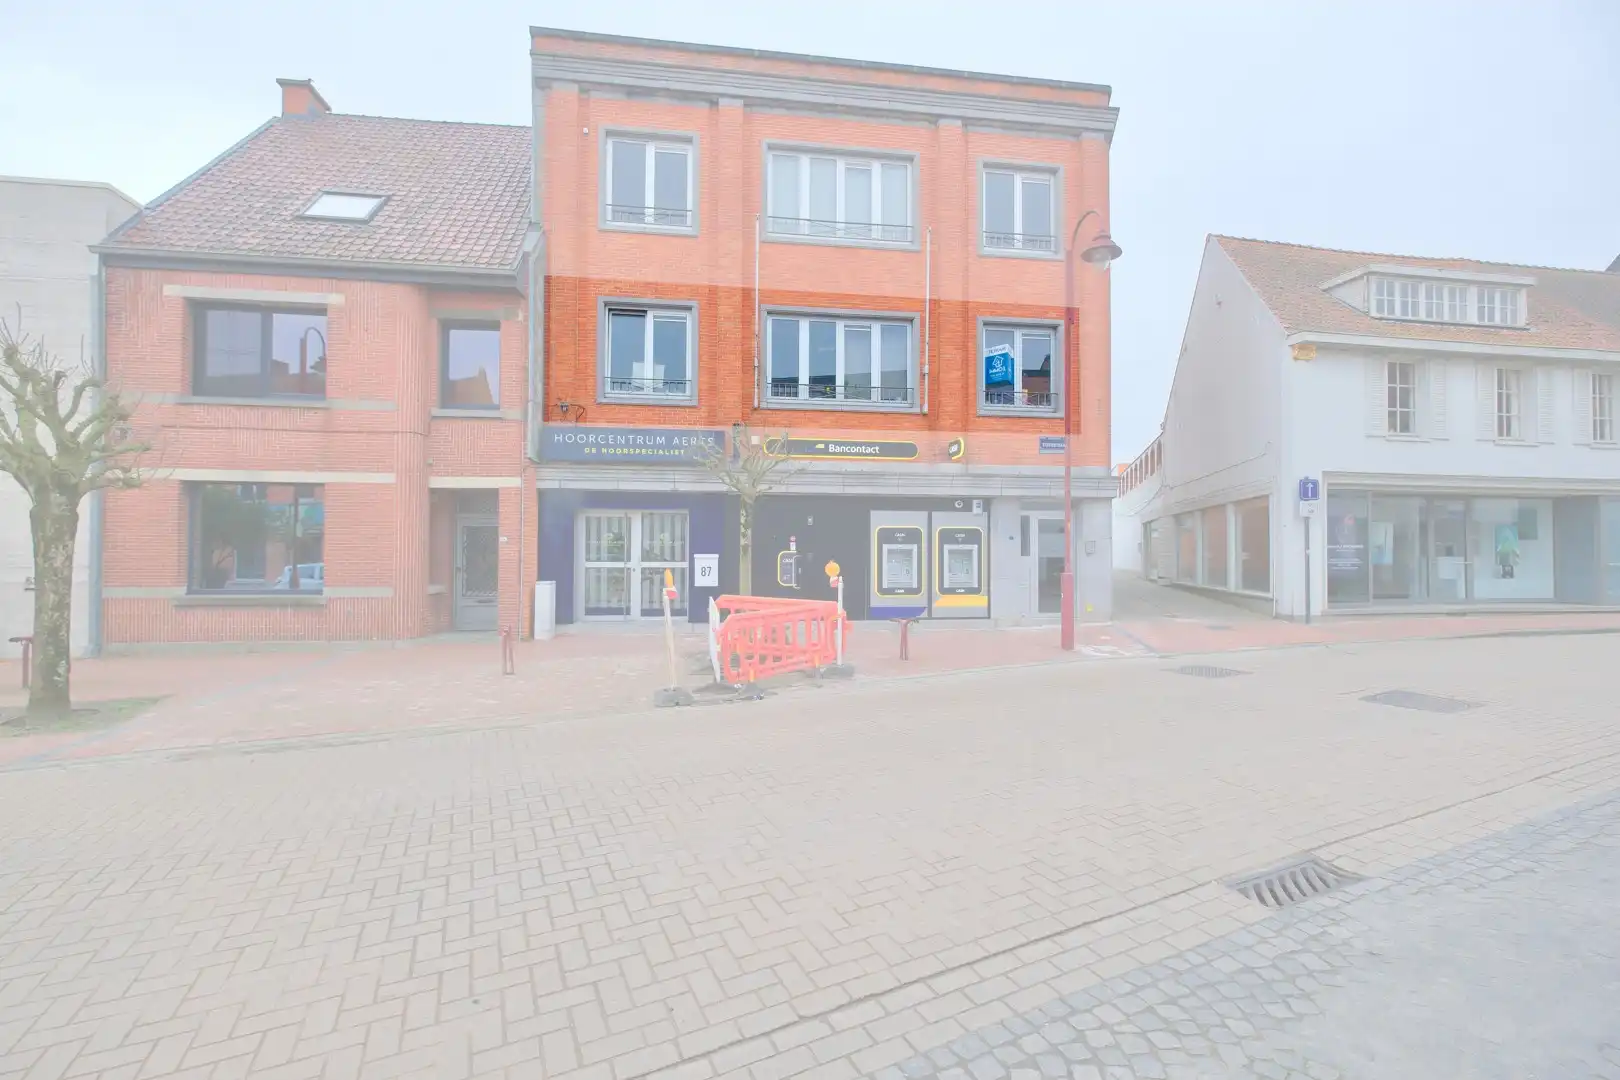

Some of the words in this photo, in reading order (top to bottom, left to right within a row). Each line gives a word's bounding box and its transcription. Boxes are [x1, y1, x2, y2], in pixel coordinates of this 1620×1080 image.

[554, 433, 665, 446] HOORCENTRUM
[672, 436, 714, 447] AERTS
[601, 447, 685, 456] HOORSPECIALIST
[828, 443, 880, 454] Bancontact
[701, 566, 712, 577] 87
